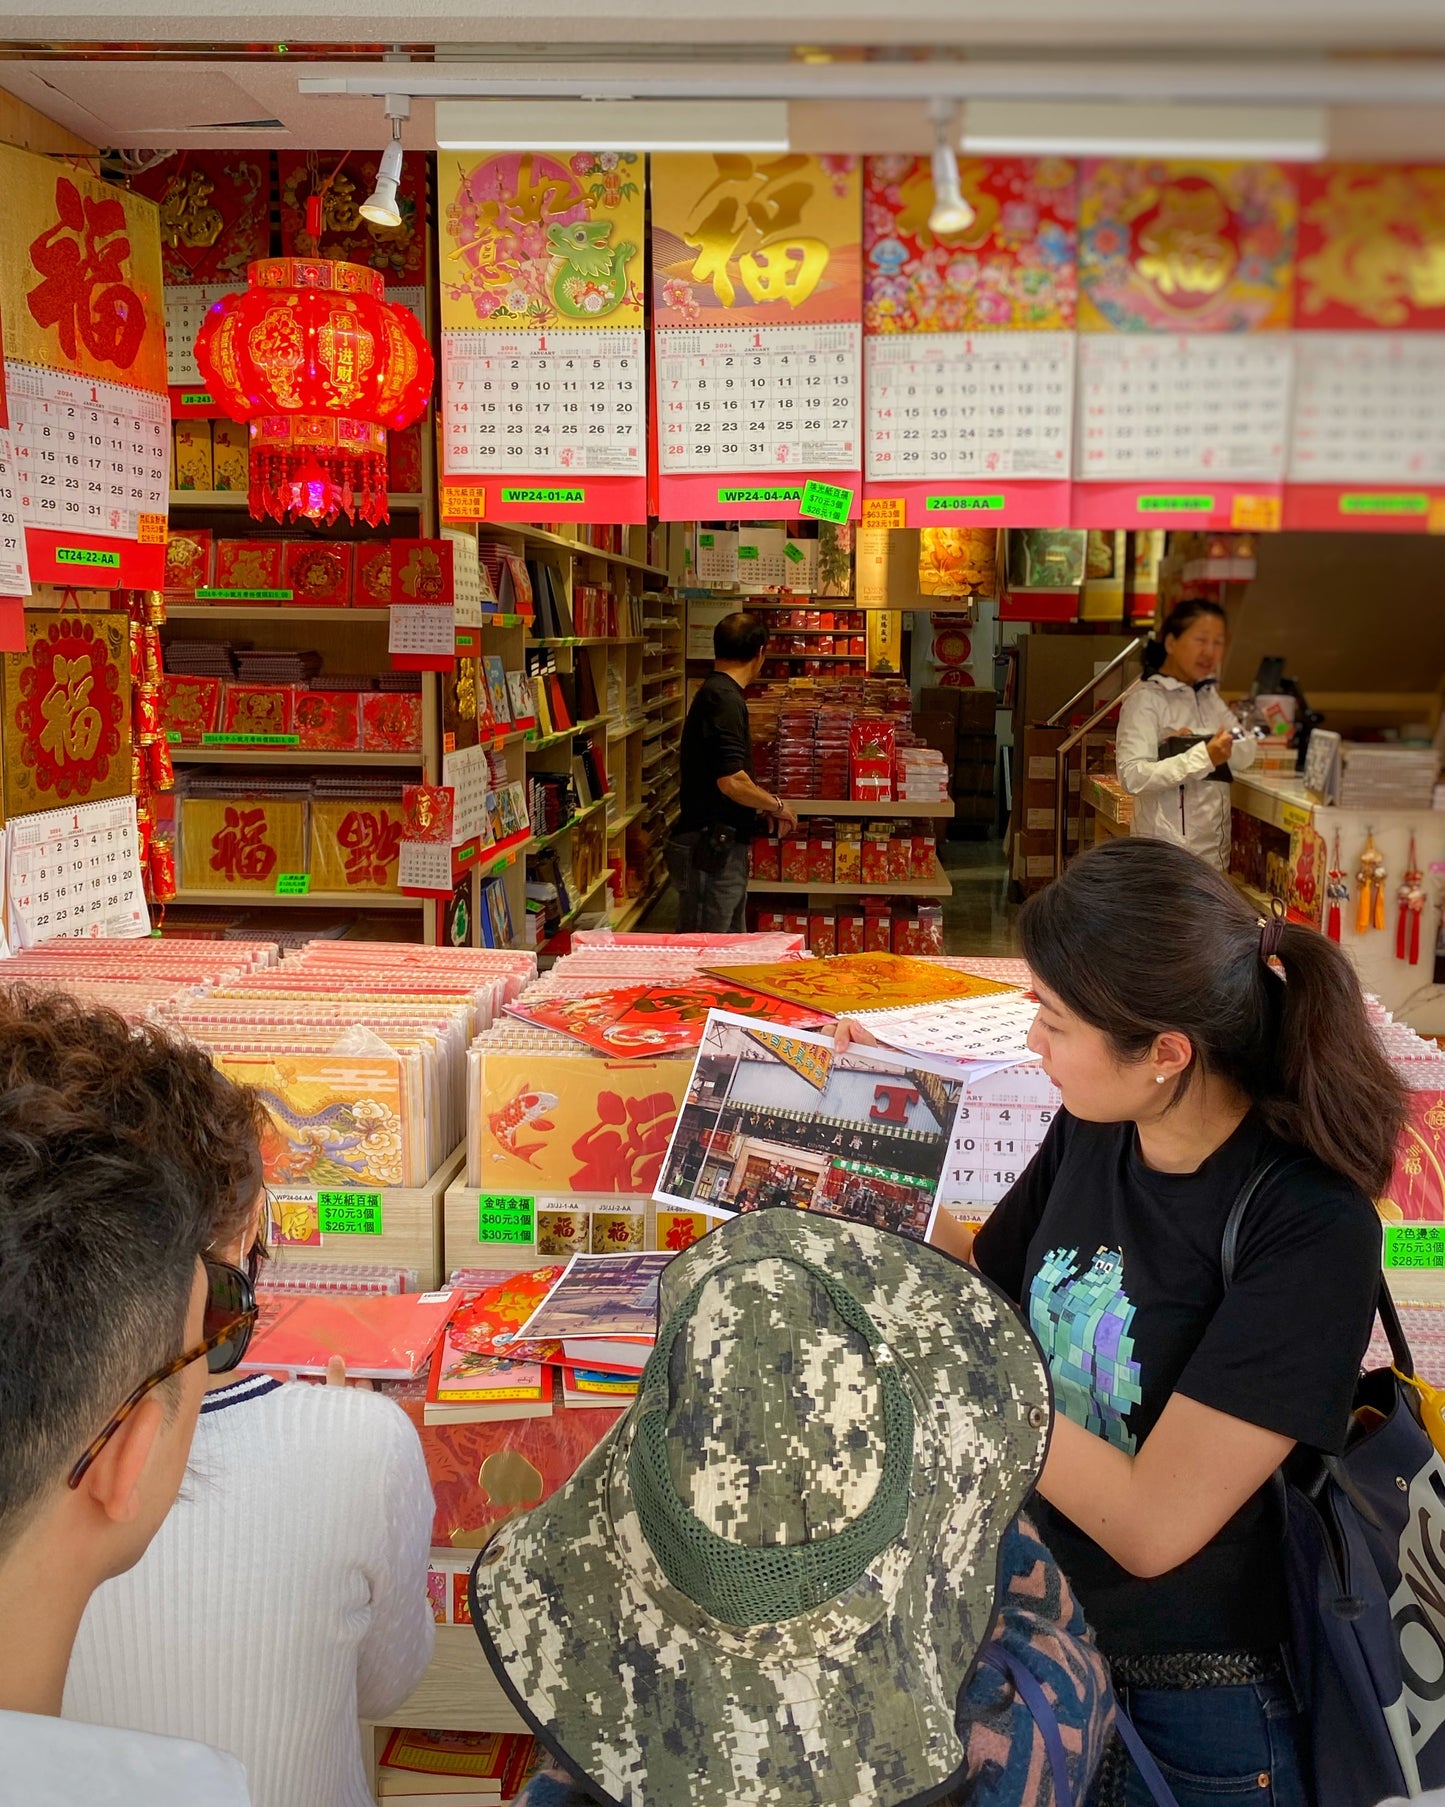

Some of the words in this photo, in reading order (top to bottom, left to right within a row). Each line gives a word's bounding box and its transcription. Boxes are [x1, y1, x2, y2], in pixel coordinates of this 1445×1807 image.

[684, 154, 830, 309] 福
[27, 177, 146, 369] 福
[336, 315, 354, 383] 添丁进财
[538, 337, 547, 350] 1
[486, 360, 490, 368] 1
[512, 360, 518, 368] 2
[538, 360, 546, 368] 3
[566, 360, 574, 368] 4
[592, 360, 600, 368] 5
[620, 360, 628, 368] 6
[456, 382, 464, 390] 7
[484, 382, 492, 390] 8
[510, 382, 518, 390] 9
[536, 382, 550, 390] 10
[562, 382, 576, 390] 11
[590, 382, 604, 390] 12
[618, 382, 632, 390] 13
[672, 380, 678, 388] 7
[698, 380, 706, 388] 8
[726, 380, 734, 388] 9
[750, 378, 766, 386] 10
[778, 378, 792, 386] 11
[806, 376, 820, 386] 12
[834, 376, 848, 384] 13
[90, 388, 98, 402] 1
[454, 404, 468, 412] 14
[480, 404, 496, 412] 15
[508, 404, 522, 412] 16
[536, 404, 550, 412] 17
[562, 404, 578, 412] 18
[590, 404, 604, 412] 19
[616, 404, 632, 412] 20
[42, 404, 48, 412] 1
[68, 408, 74, 416] 2
[90, 412, 98, 422] 3
[114, 418, 120, 426] 4
[134, 422, 140, 430] 5
[154, 426, 160, 434] 6
[452, 424, 466, 432] 21
[480, 424, 496, 434] 22
[508, 424, 522, 434] 23
[534, 426, 550, 434] 24
[562, 426, 578, 434] 25
[588, 424, 604, 434] 26
[616, 426, 632, 434] 27
[16, 422, 24, 432] 7
[42, 426, 50, 436] 8
[68, 432, 74, 440] 9
[88, 436, 102, 446] 10
[112, 440, 122, 450] 11
[132, 444, 144, 454] 12
[152, 448, 162, 456] 13
[454, 446, 468, 454] 28
[480, 446, 496, 454] 29
[506, 446, 522, 454] 30
[534, 446, 548, 454] 31
[14, 446, 28, 458] 14
[40, 450, 54, 460] 15
[66, 454, 78, 464] 16
[88, 458, 102, 468] 17
[112, 462, 124, 472] 18
[132, 466, 144, 476] 19
[150, 470, 162, 478] 20
[876, 452, 892, 462] 28
[904, 452, 918, 460] 29
[930, 452, 948, 460] 30
[960, 452, 974, 460] 31
[40, 474, 56, 486] 22
[66, 478, 78, 488] 23
[88, 482, 102, 492] 24
[0, 488, 12, 498] 13
[509, 490, 583, 501] WP24-01-AA
[724, 490, 800, 501] WP24-04-AA
[448, 498, 480, 506] $70元3個
[932, 498, 990, 510] 24-08-AA
[2, 512, 14, 524] 20
[4, 538, 16, 548] 27
[58, 550, 114, 564] CT24-22-AA
[40, 654, 102, 766] 福
[209, 806, 277, 882] 福
[18, 896, 30, 908] 14
[38, 892, 48, 902] 15
[56, 888, 66, 898] 16
[74, 882, 84, 892] 17
[92, 878, 100, 888] 18
[108, 874, 116, 884] 19
[122, 870, 132, 880] 20
[960, 1108, 970, 1120] 3
[1000, 1110, 1010, 1120] 4
[1040, 1112, 1052, 1122] 5
[954, 1138, 974, 1150] 10
[994, 1140, 1014, 1152] 11
[952, 1170, 974, 1182] 17
[994, 1172, 1016, 1184] 18
[321, 1194, 379, 1206] 珠光紙百福
[484, 1196, 530, 1210] 金咭金福
[324, 1208, 374, 1219] $70元3個
[282, 1206, 313, 1242] 福
[325, 1220, 375, 1232] $26元1個
[482, 1214, 532, 1226] $80元3個
[553, 1218, 575, 1238] 福
[608, 1221, 630, 1242] 福
[1396, 1228, 1440, 1240] 2色燙金
[482, 1229, 532, 1241] $30元1個
[1392, 1242, 1444, 1253] $75元3個
[1392, 1255, 1444, 1266] $28元1個
